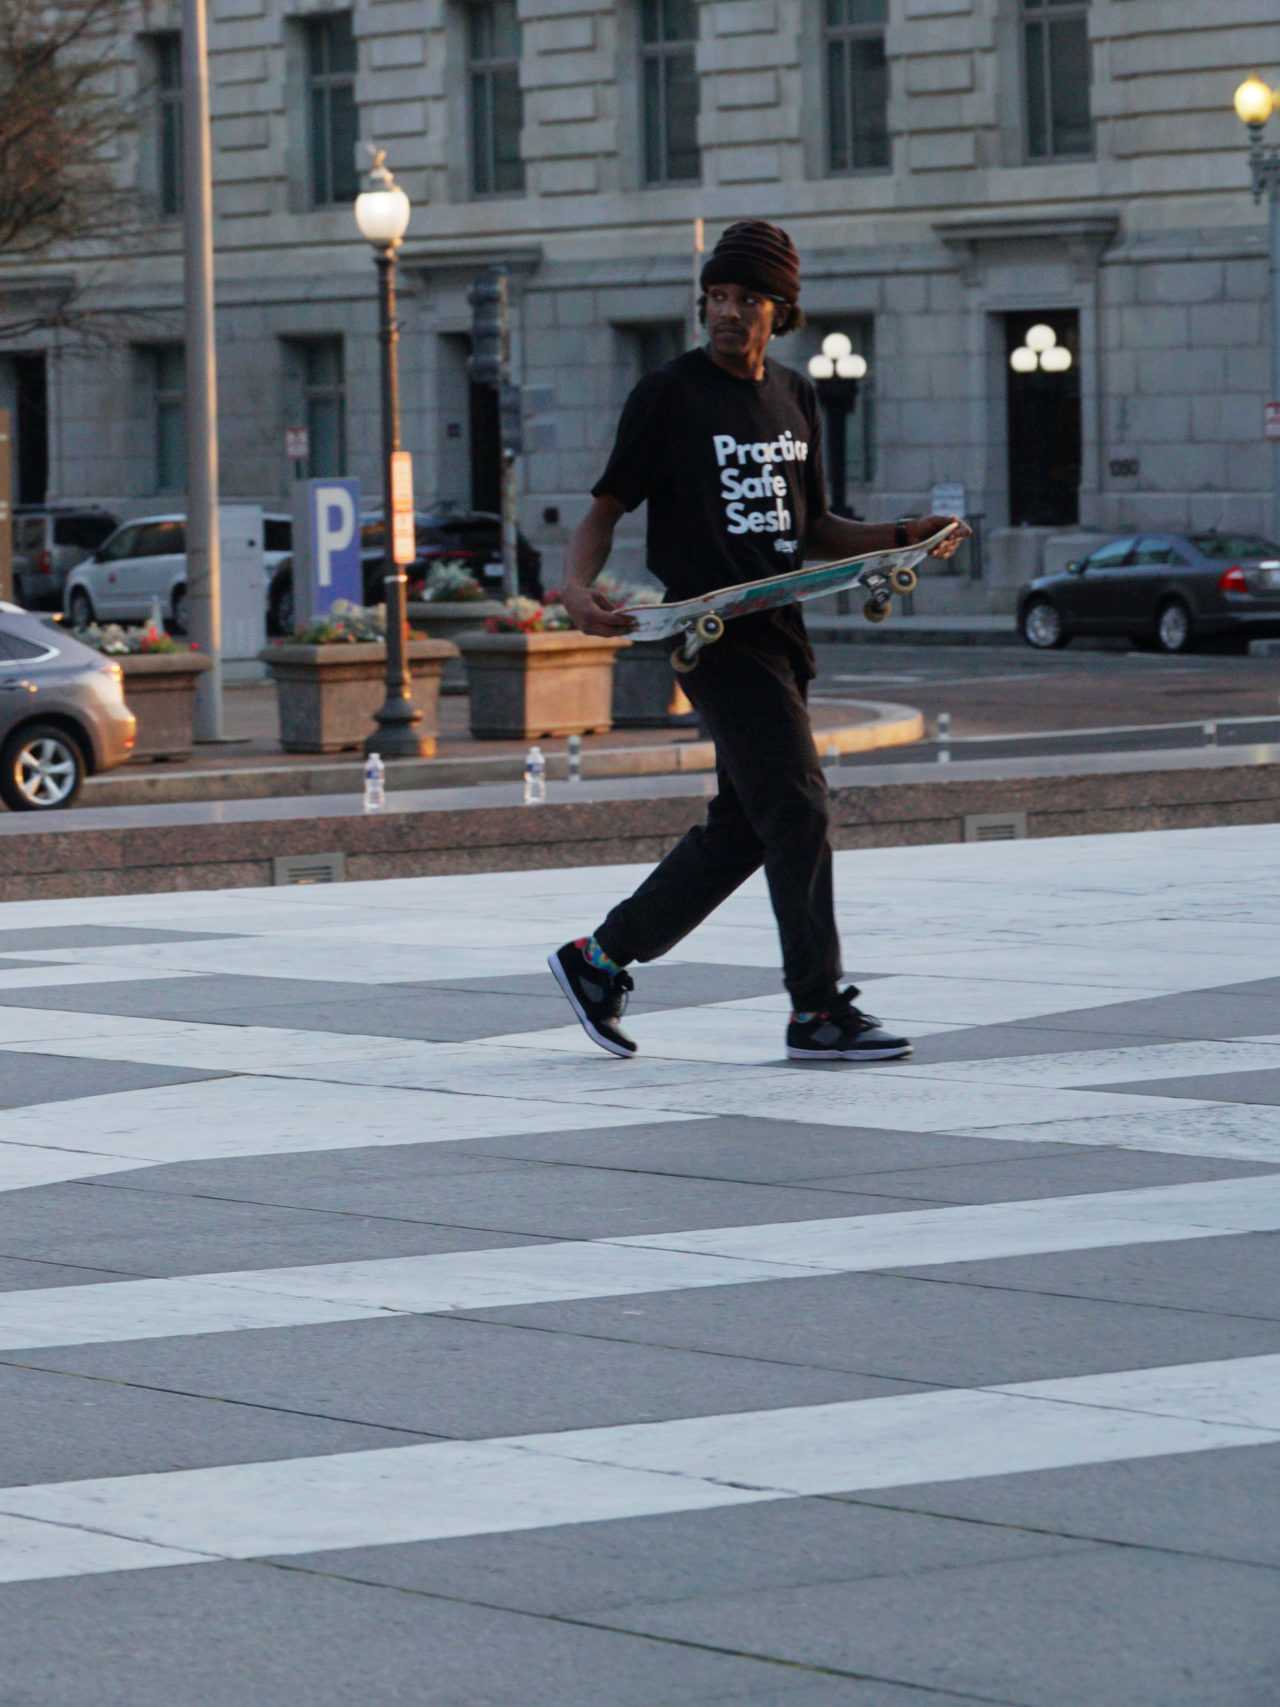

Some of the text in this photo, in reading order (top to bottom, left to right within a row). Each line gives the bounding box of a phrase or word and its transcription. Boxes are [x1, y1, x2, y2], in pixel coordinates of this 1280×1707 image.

[712, 430, 809, 466] Practice
[720, 464, 788, 501] Safe
[726, 498, 792, 534] Sesh
[315, 486, 355, 587] P
